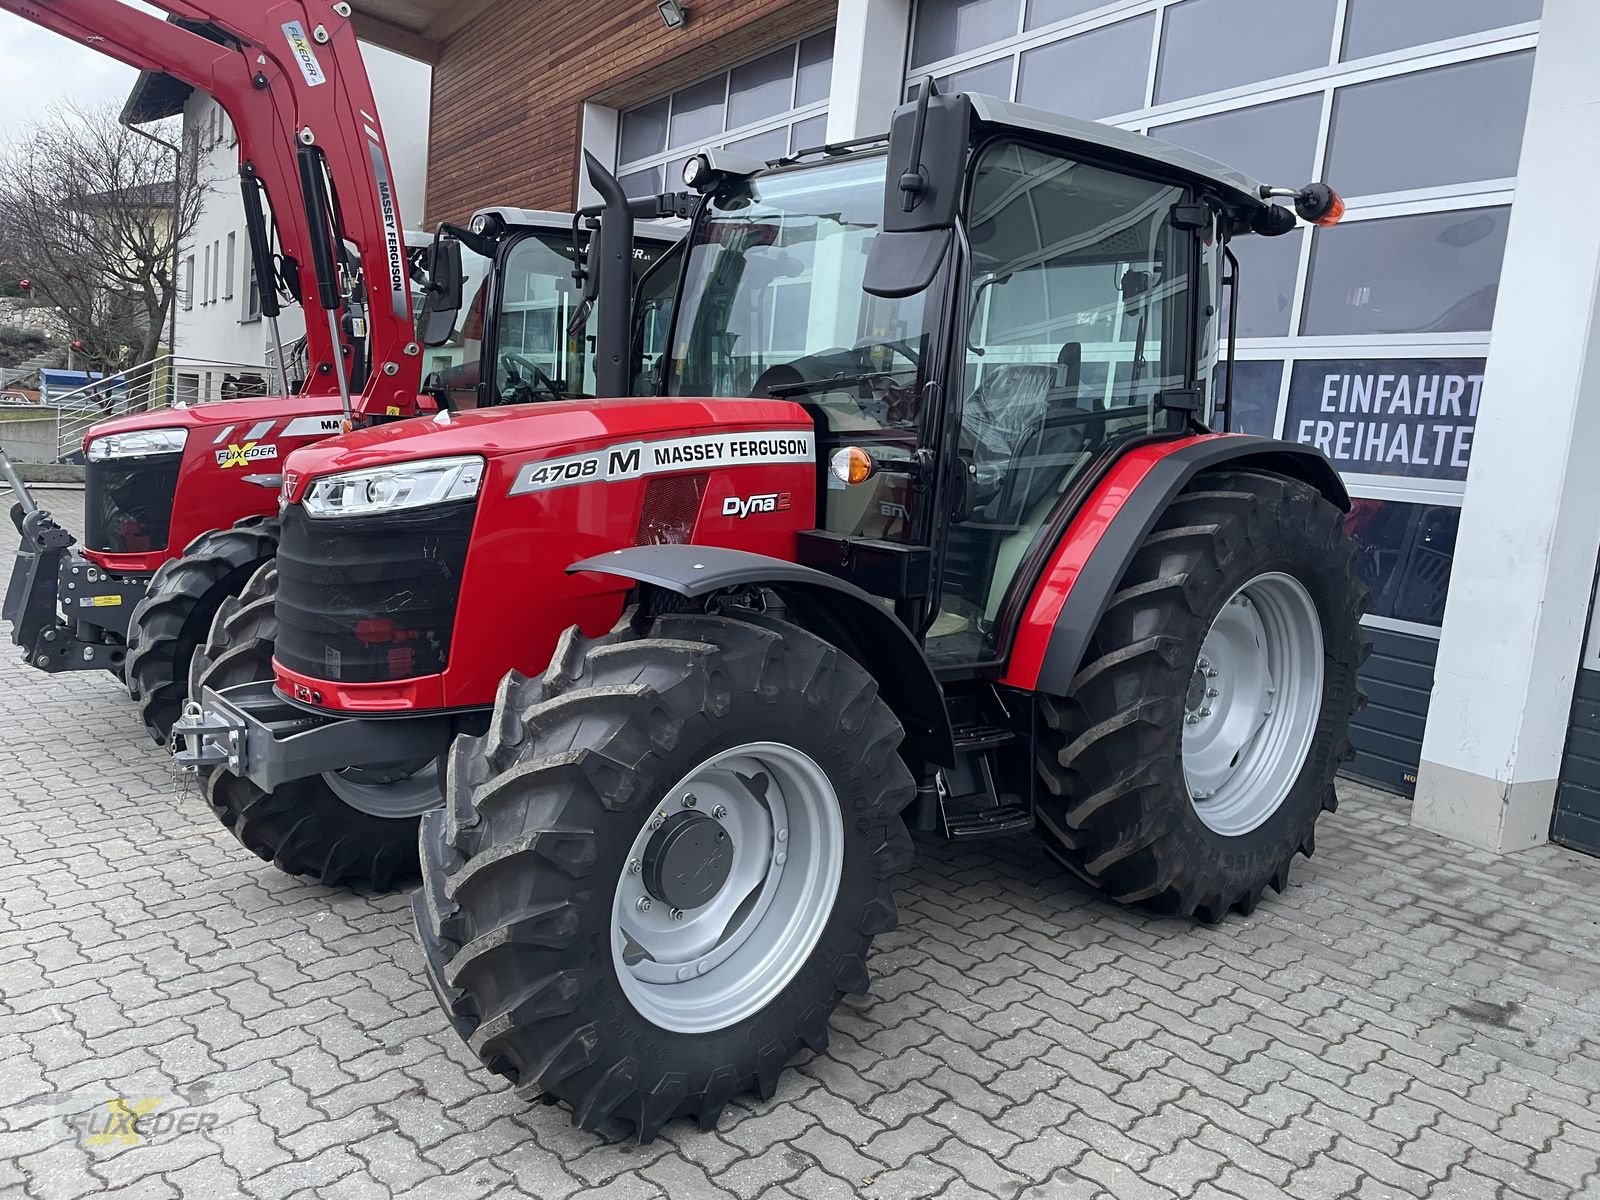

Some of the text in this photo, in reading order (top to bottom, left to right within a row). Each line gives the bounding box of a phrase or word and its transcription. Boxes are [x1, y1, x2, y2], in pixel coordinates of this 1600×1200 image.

[378, 181, 402, 291] MASSEY FERGUSON
[1320, 374, 1484, 417] EINFAHRT
[217, 446, 276, 461] FLIXEDER
[531, 439, 807, 484] 4708 M MASSEY FERGUSON
